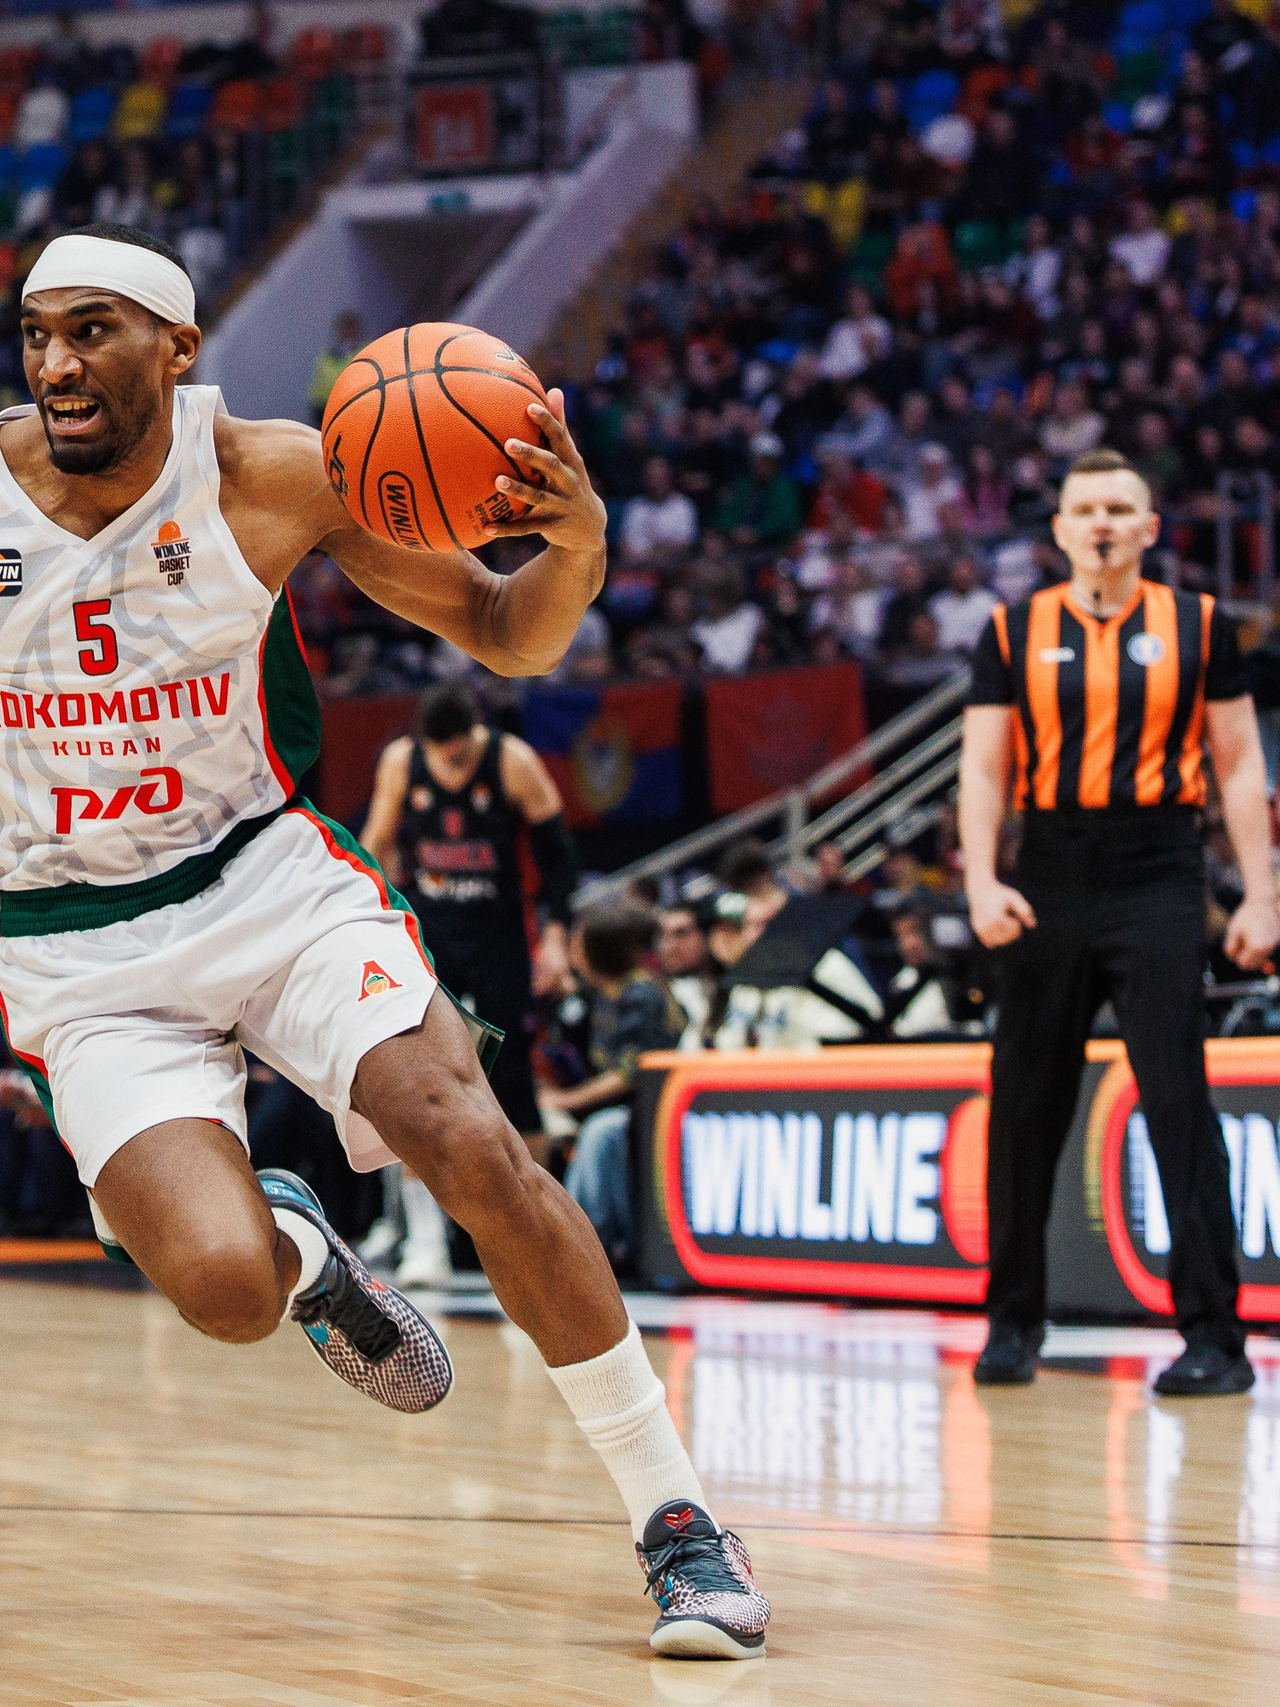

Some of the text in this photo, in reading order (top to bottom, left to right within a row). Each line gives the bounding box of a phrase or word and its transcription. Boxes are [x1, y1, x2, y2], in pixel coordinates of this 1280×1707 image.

[153, 541, 192, 558] WINLINE
[159, 556, 191, 573] BASKET
[167, 573, 184, 586] CUP
[73, 598, 119, 676] 5
[53, 737, 161, 756] KUBAN
[681, 1111, 947, 1245] WINLINE
